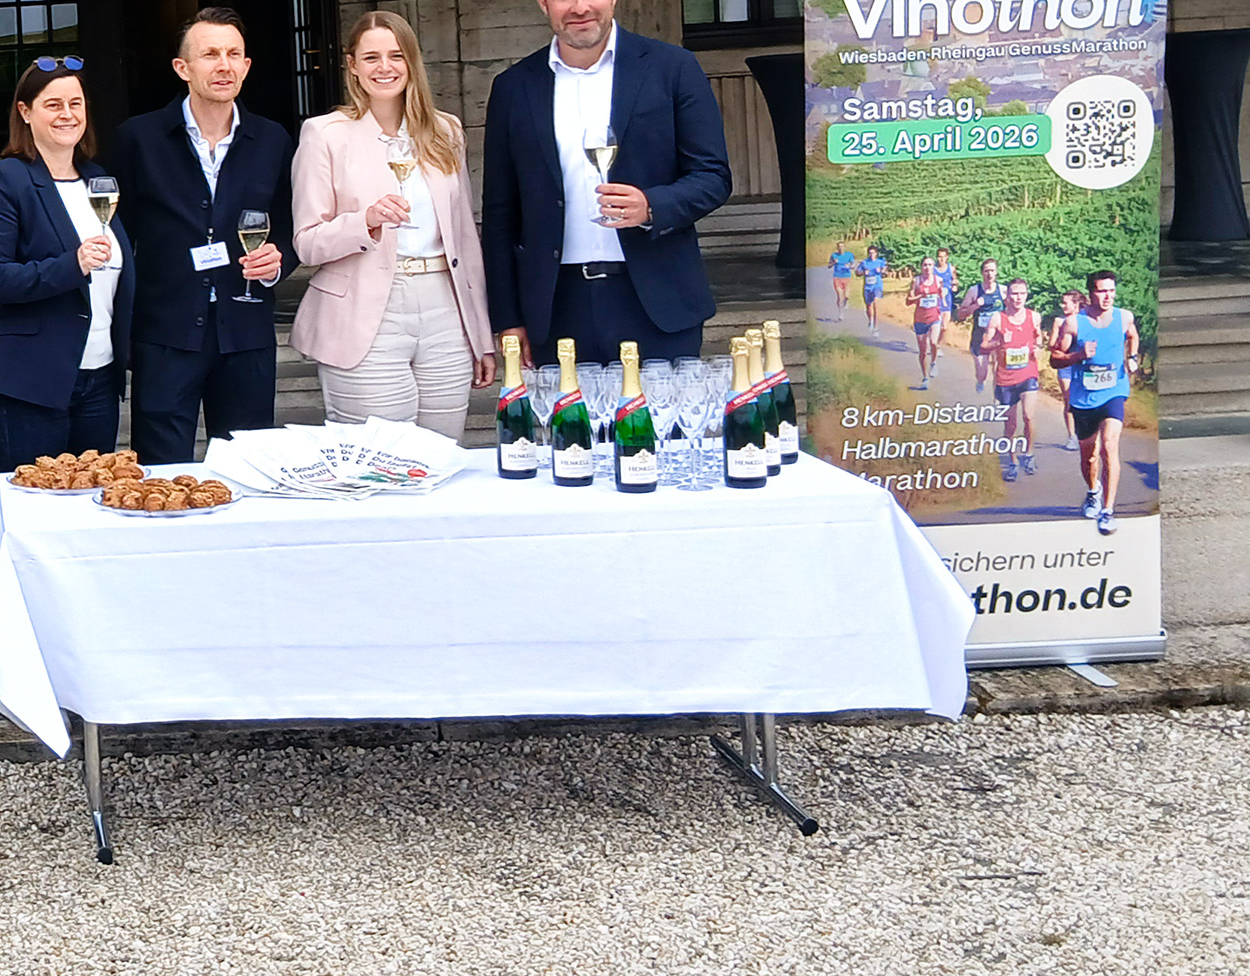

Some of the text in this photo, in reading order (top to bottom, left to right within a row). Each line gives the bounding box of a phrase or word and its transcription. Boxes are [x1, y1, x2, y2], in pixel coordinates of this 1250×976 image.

[1008, 38, 1147, 56] GenussMarathon
[842, 95, 984, 122] Samstag,
[841, 123, 1040, 159] 25. April 2026
[841, 432, 1028, 460] Halbmarathon
[859, 468, 979, 491] arathon
[1042, 547, 1115, 569] unter
[971, 577, 1133, 615] thon.de
